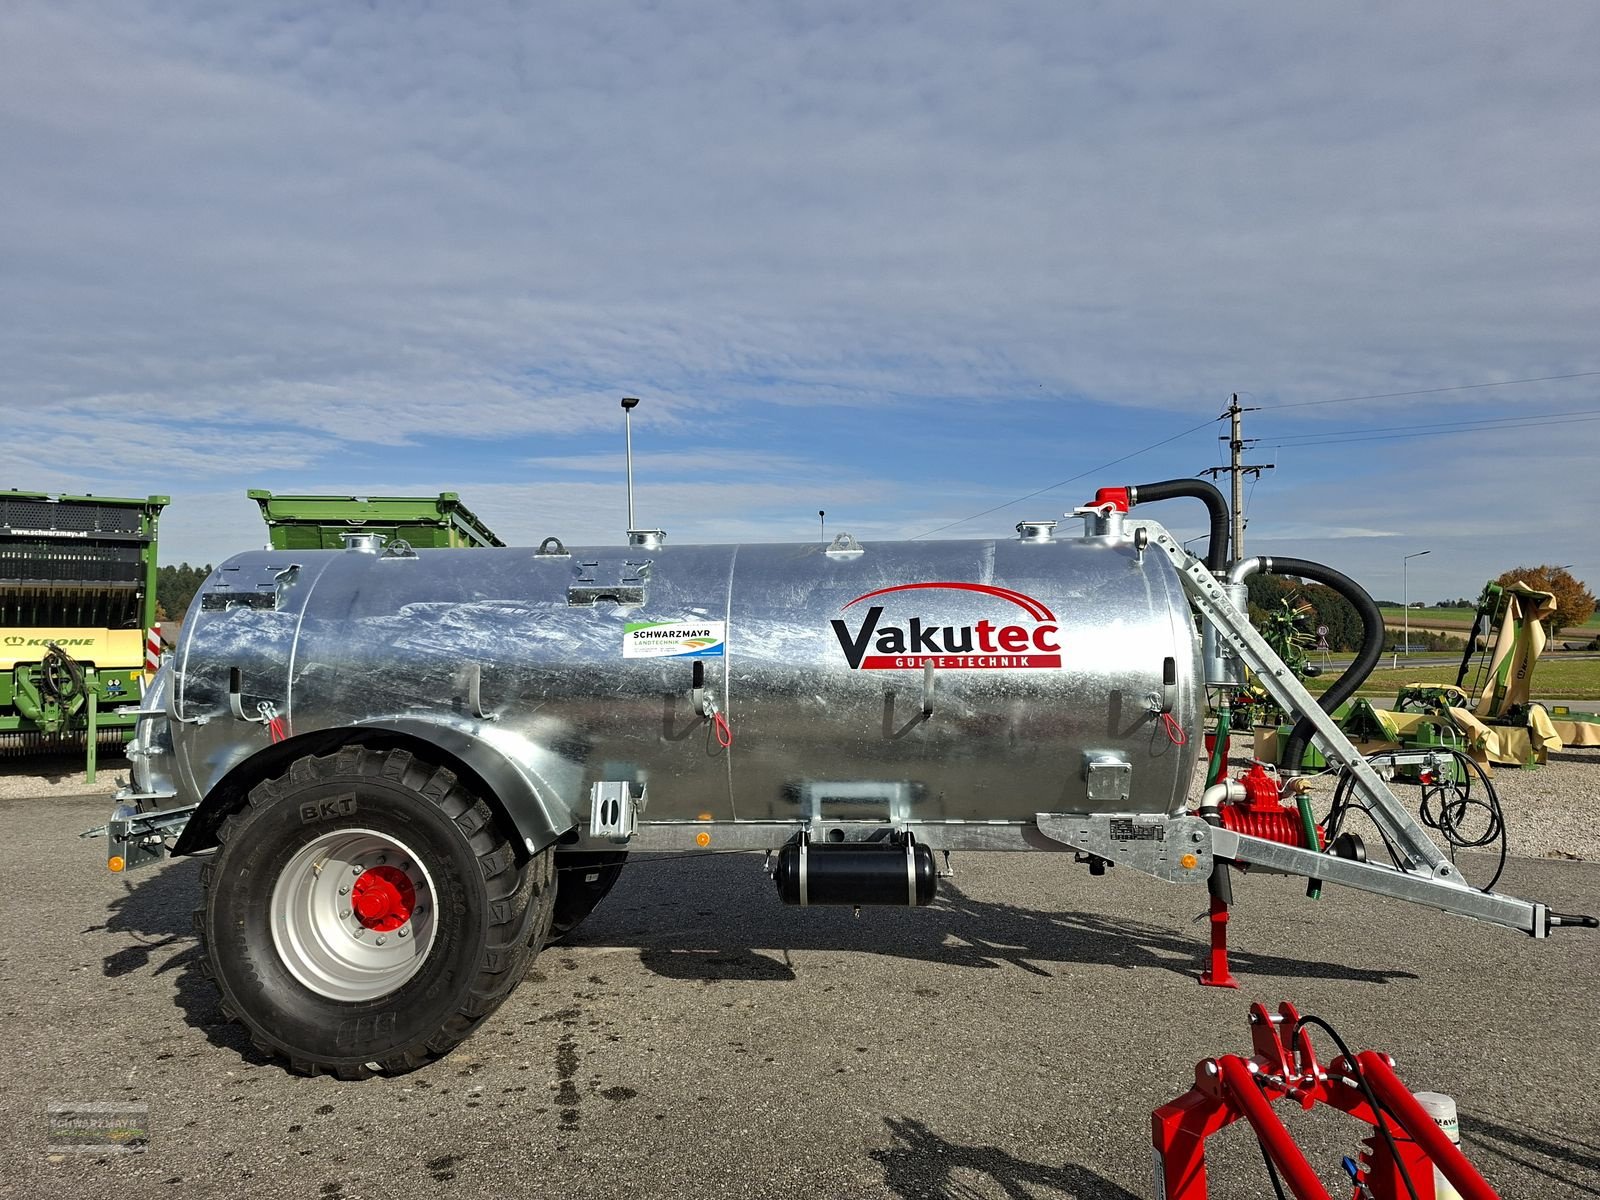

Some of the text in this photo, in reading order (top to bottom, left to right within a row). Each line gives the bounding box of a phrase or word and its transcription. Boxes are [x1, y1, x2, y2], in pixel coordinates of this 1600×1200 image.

[633, 629, 711, 639] SCHWARZMAYR
[830, 606, 1062, 669] Vakutec
[895, 656, 1030, 668] GÜLE-TECHNIK
[301, 798, 353, 821] BKT
